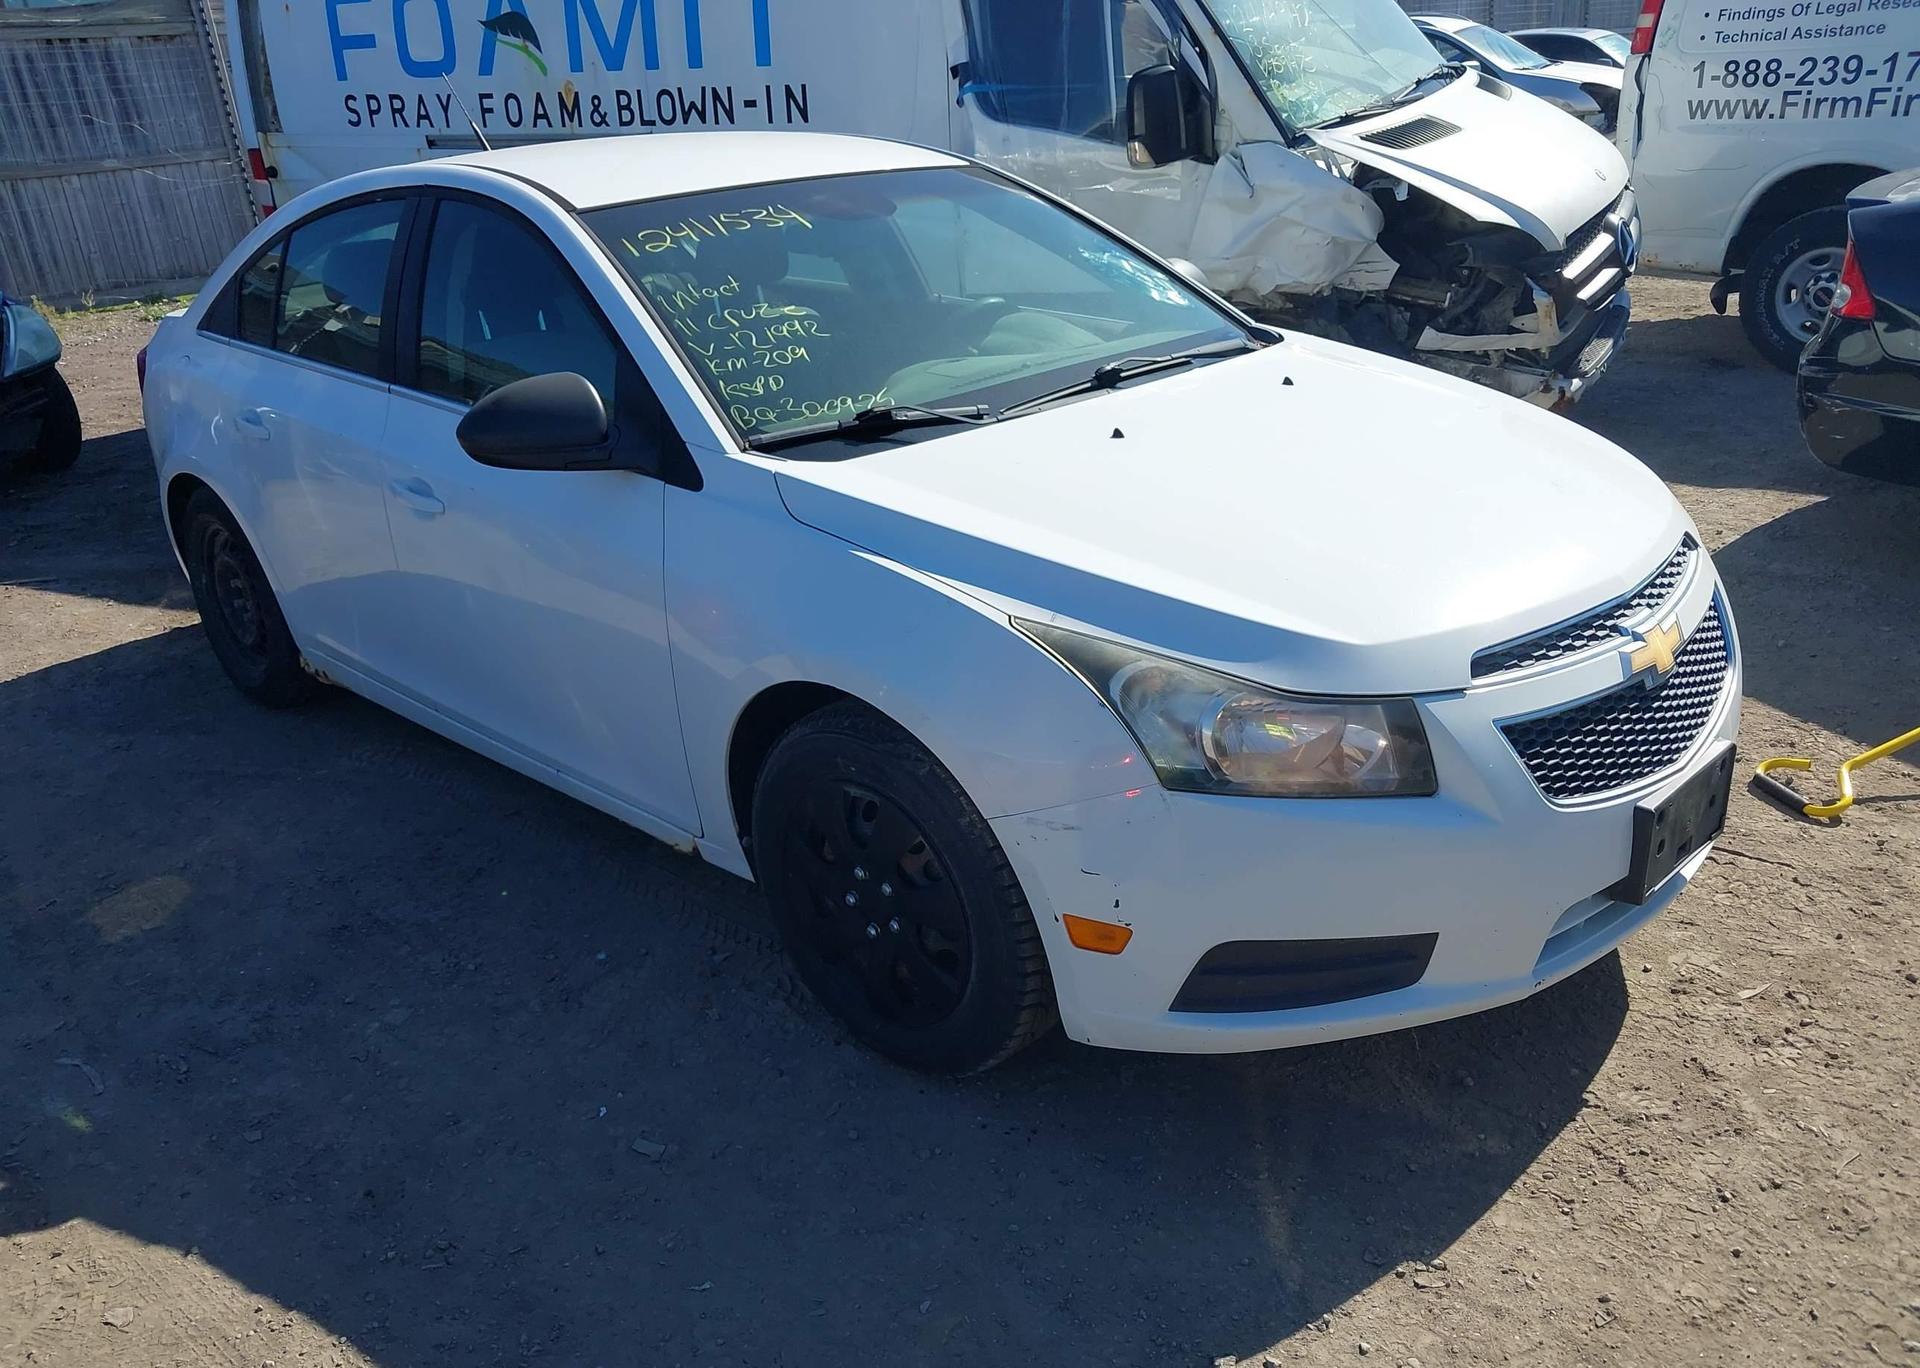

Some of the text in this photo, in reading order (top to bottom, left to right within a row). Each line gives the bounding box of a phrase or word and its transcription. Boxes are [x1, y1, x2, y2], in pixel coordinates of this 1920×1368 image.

[1717, 7, 1785, 22] Findings
[1791, 2, 1812, 17] Of
[1815, 0, 1863, 16] Legal
[1714, 23, 1886, 44] Technical Assistance
[344, 93, 452, 128] SPRAY
[620, 204, 813, 257] 12411534
